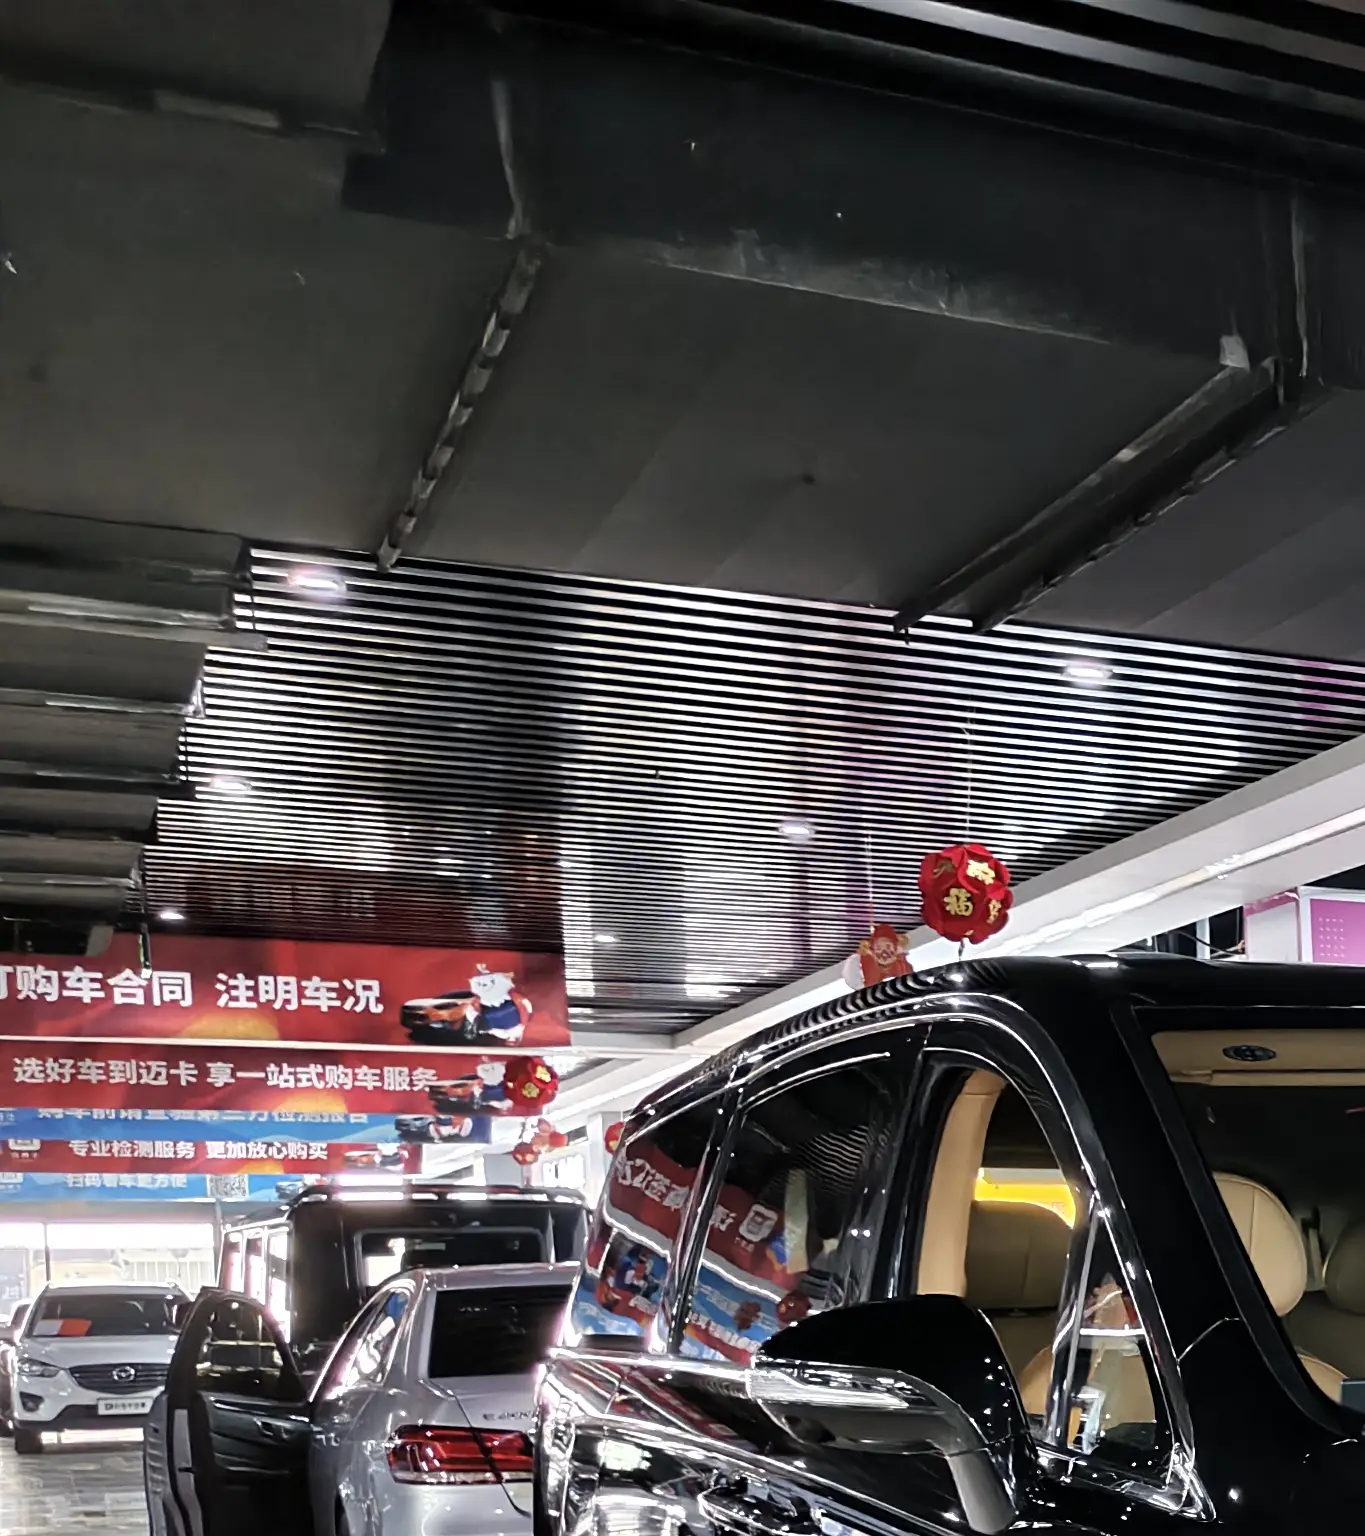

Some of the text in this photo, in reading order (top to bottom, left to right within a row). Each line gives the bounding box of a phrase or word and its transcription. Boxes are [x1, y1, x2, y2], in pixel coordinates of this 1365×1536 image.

[215, 974, 385, 1014] 注明车况
[13, 1057, 439, 1092] 选好车到迈卡 享一站式购车服务
[68, 1140, 328, 1161] 专业检测服务 更加放心购买
